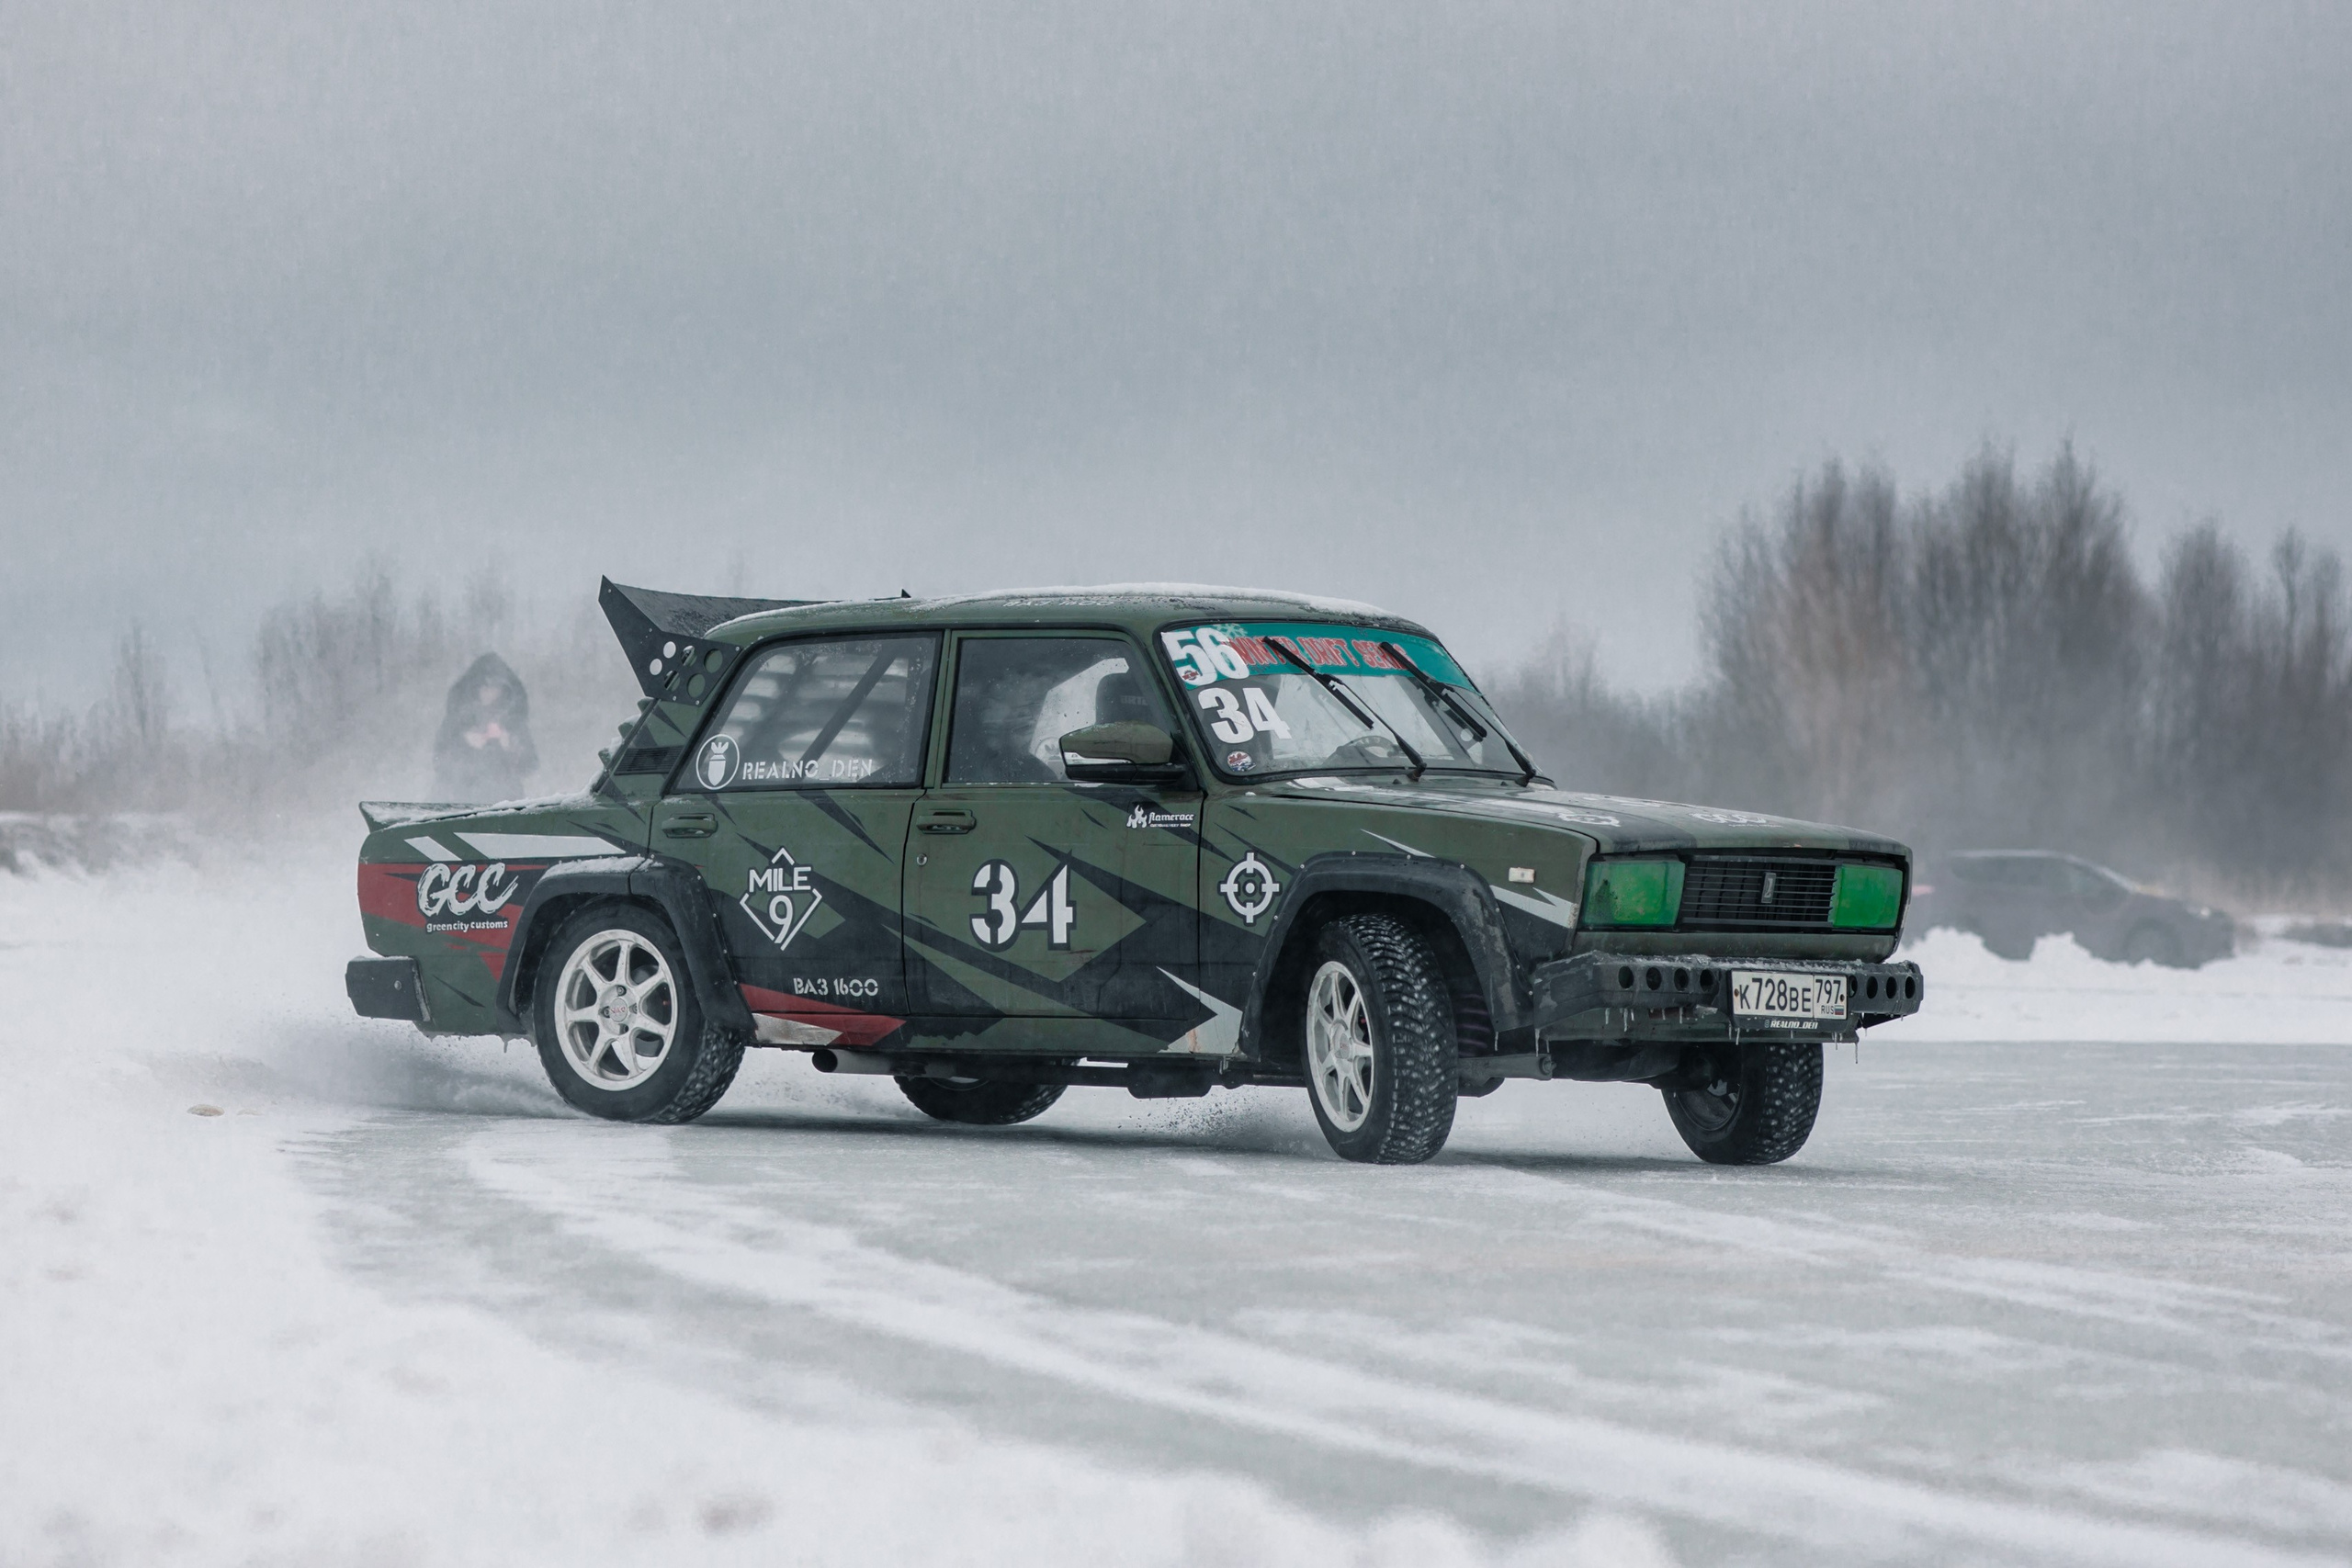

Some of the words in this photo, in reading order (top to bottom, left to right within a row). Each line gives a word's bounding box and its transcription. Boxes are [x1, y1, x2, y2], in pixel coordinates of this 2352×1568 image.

[1160, 627, 1250, 686] 56
[1296, 637, 1360, 667] DRIFT
[1197, 687, 1293, 744] 34
[1148, 812, 1194, 825] flamerace
[417, 862, 519, 918] GCC
[749, 866, 812, 893] MILE
[971, 863, 1074, 944] 34
[470, 920, 508, 930] customs
[768, 895, 794, 943] 9
[833, 977, 879, 997] 1600
[1815, 978, 1841, 1005] 797
[1820, 1005, 1835, 1015] RUS
